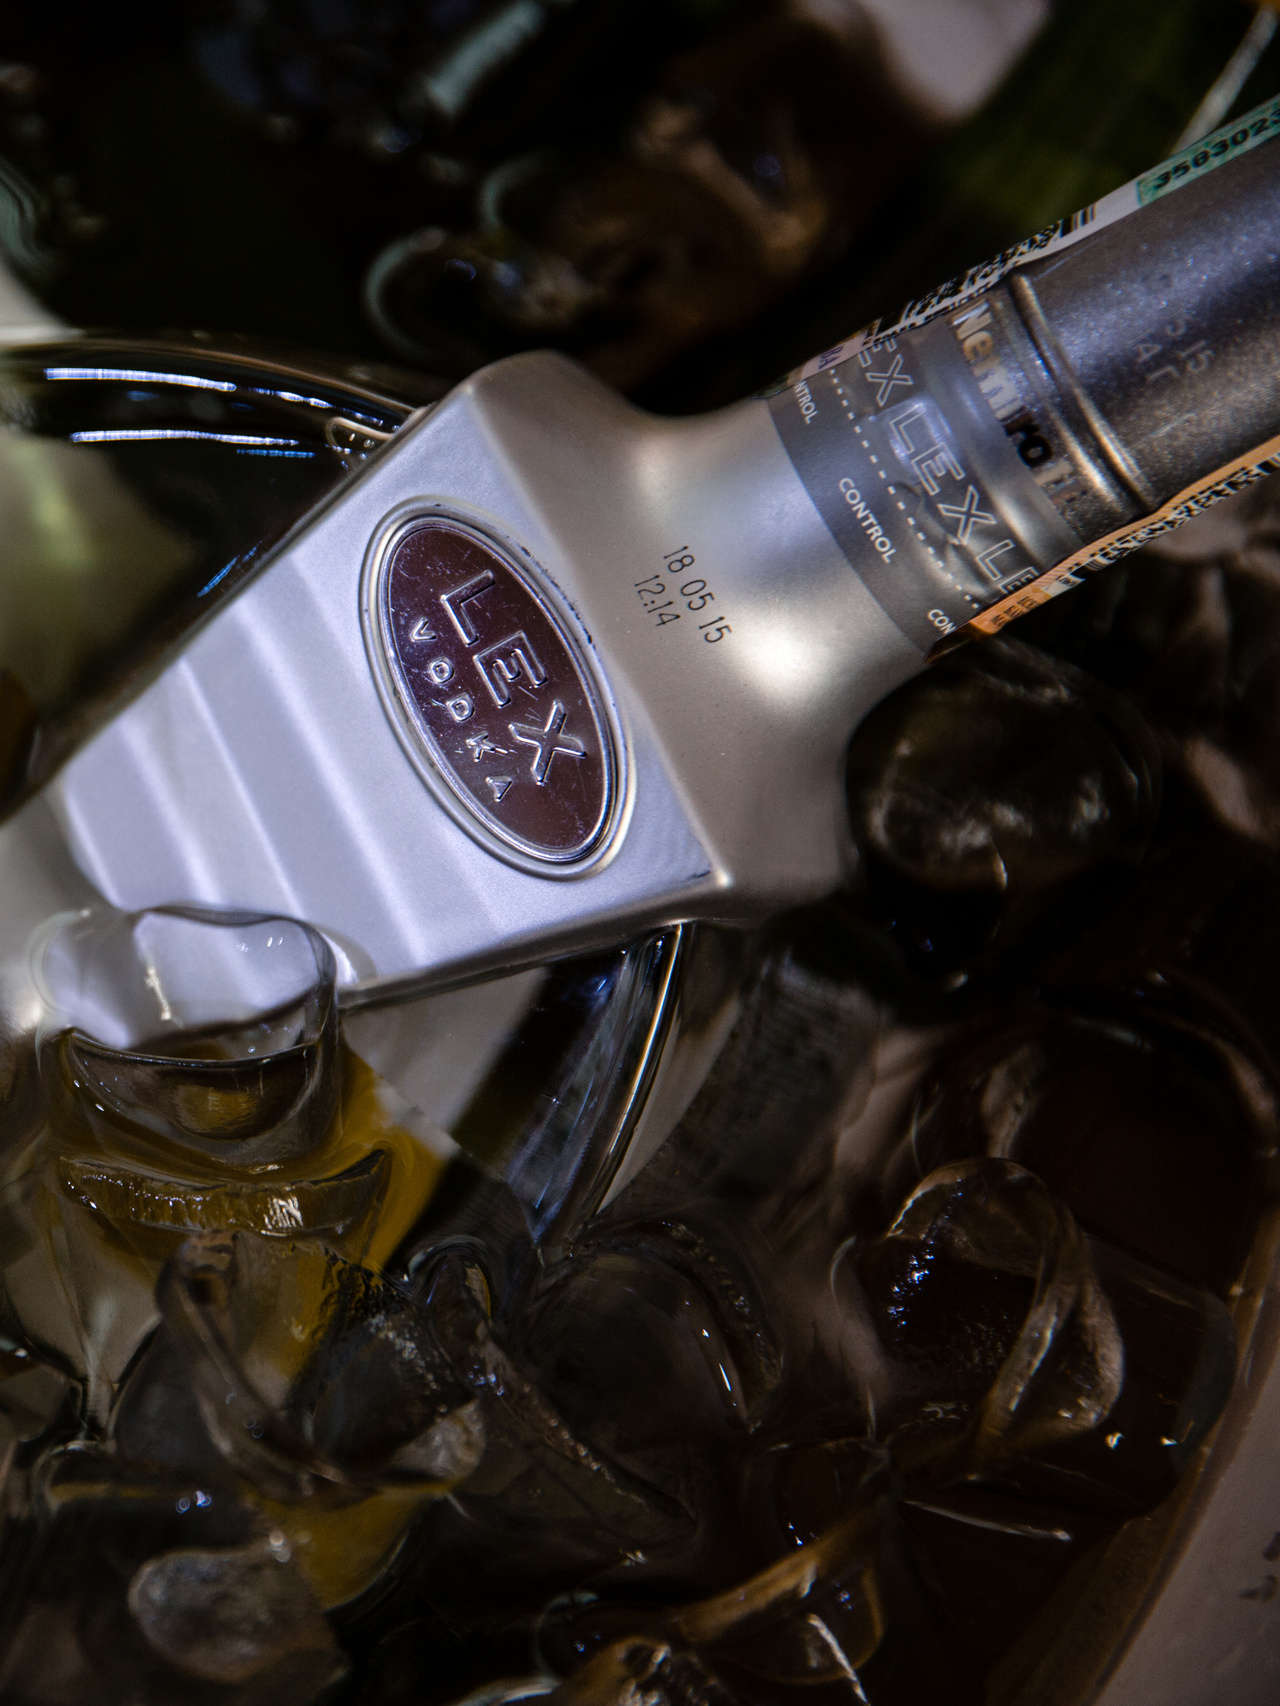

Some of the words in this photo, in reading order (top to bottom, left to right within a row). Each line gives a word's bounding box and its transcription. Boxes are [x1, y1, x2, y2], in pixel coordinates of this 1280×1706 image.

[888, 402, 998, 547] LEX
[664, 545, 696, 575] 18
[837, 476, 898, 564] CONTROL
[679, 579, 716, 612] 05
[699, 616, 733, 644] 15
[410, 616, 513, 803] VODKA
[439, 568, 588, 786] LEX
